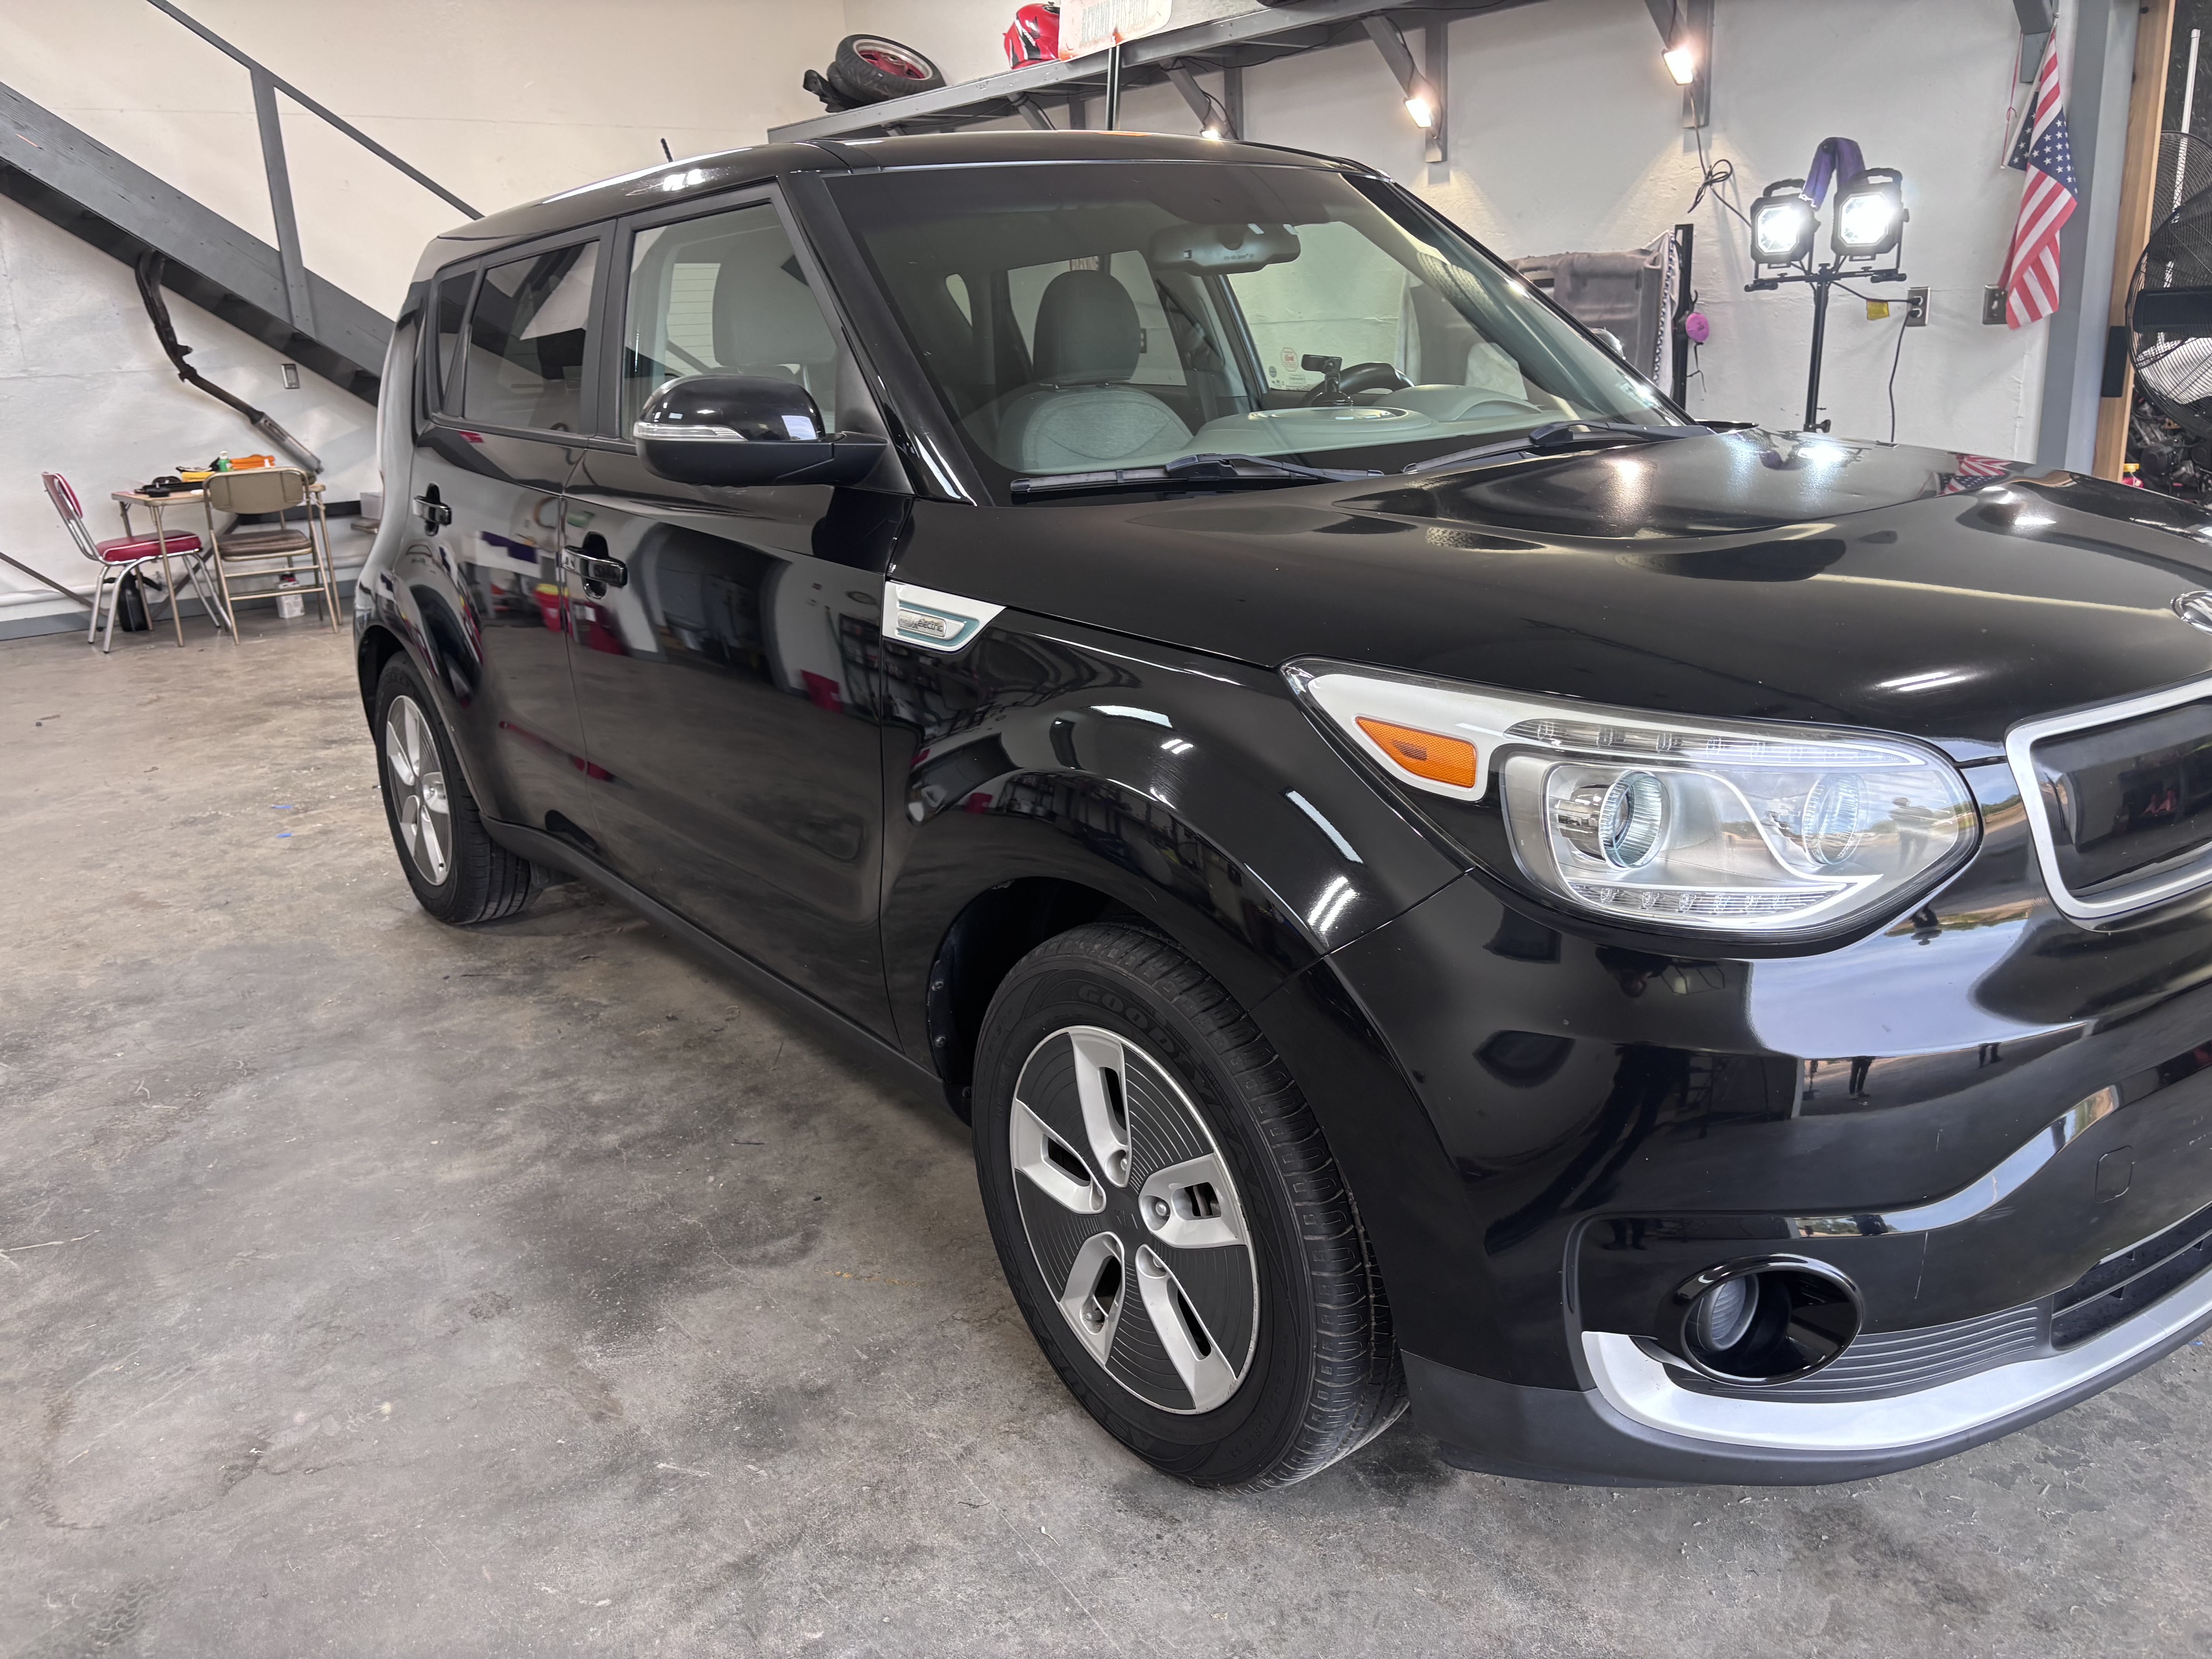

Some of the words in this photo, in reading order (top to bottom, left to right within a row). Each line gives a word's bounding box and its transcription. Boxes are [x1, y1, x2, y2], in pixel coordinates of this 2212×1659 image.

[1082, 0, 1110, 44] BEYOND
[1077, 984, 1269, 1219] GOODYEAR
[991, 1212, 1156, 1456] ASSURANCE
